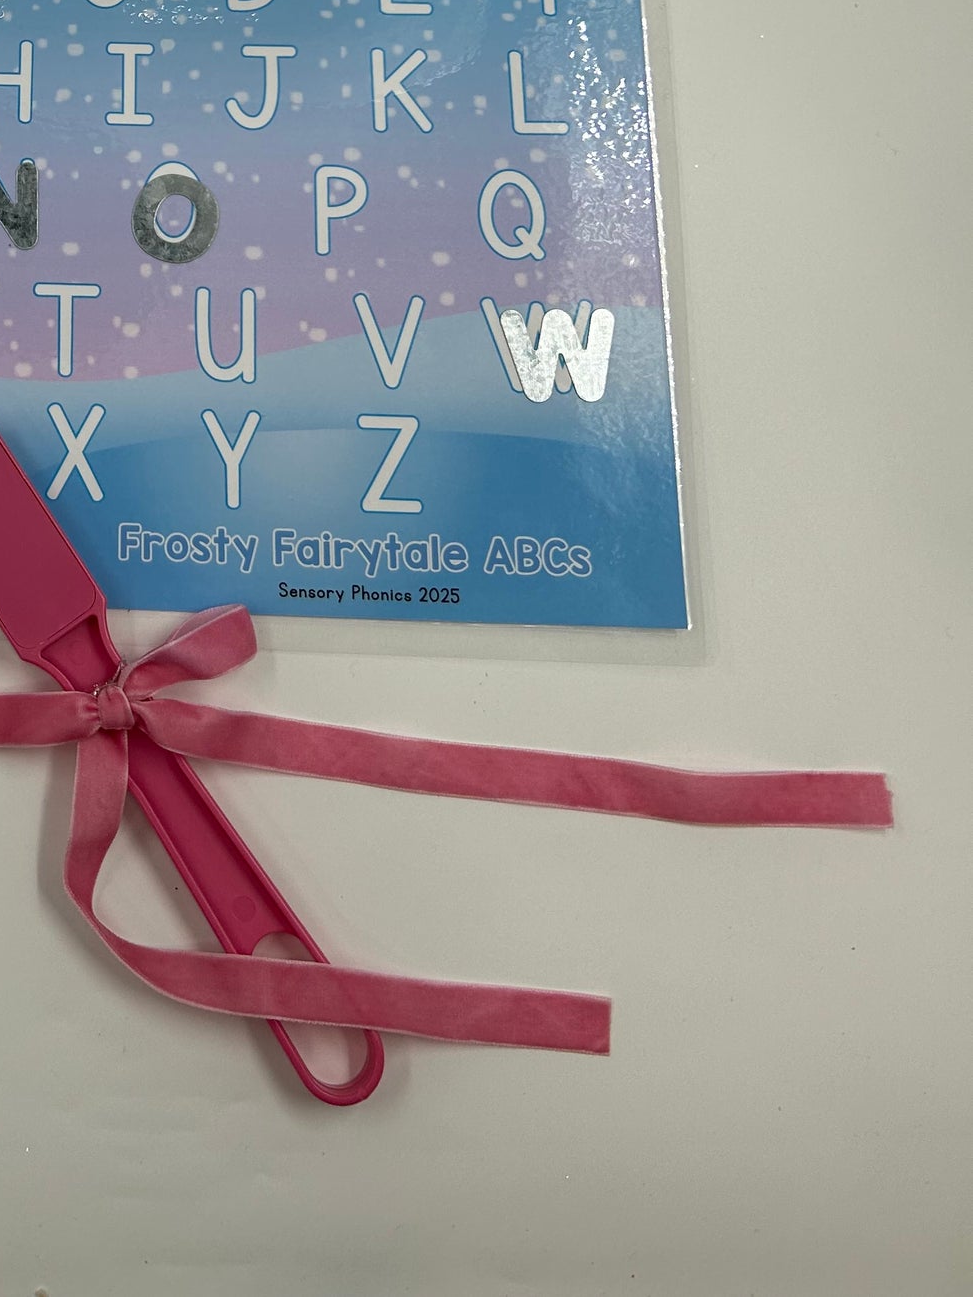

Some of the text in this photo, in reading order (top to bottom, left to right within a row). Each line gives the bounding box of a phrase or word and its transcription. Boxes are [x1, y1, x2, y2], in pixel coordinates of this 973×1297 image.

[105, 42, 155, 125] I
[225, 44, 298, 130] J
[370, 48, 434, 132] K
[508, 50, 570, 135] L
[131, 172, 220, 264] O
[313, 164, 369, 255] P
[477, 169, 546, 261] Q
[33, 282, 101, 377] T
[353, 293, 425, 389] V
[497, 306, 615, 403] W
[46, 402, 423, 513] X Y Z
[118, 522, 593, 579] Frosty Fairytale ABCs
[278, 581, 461, 604] Sensory Phonics 2025
